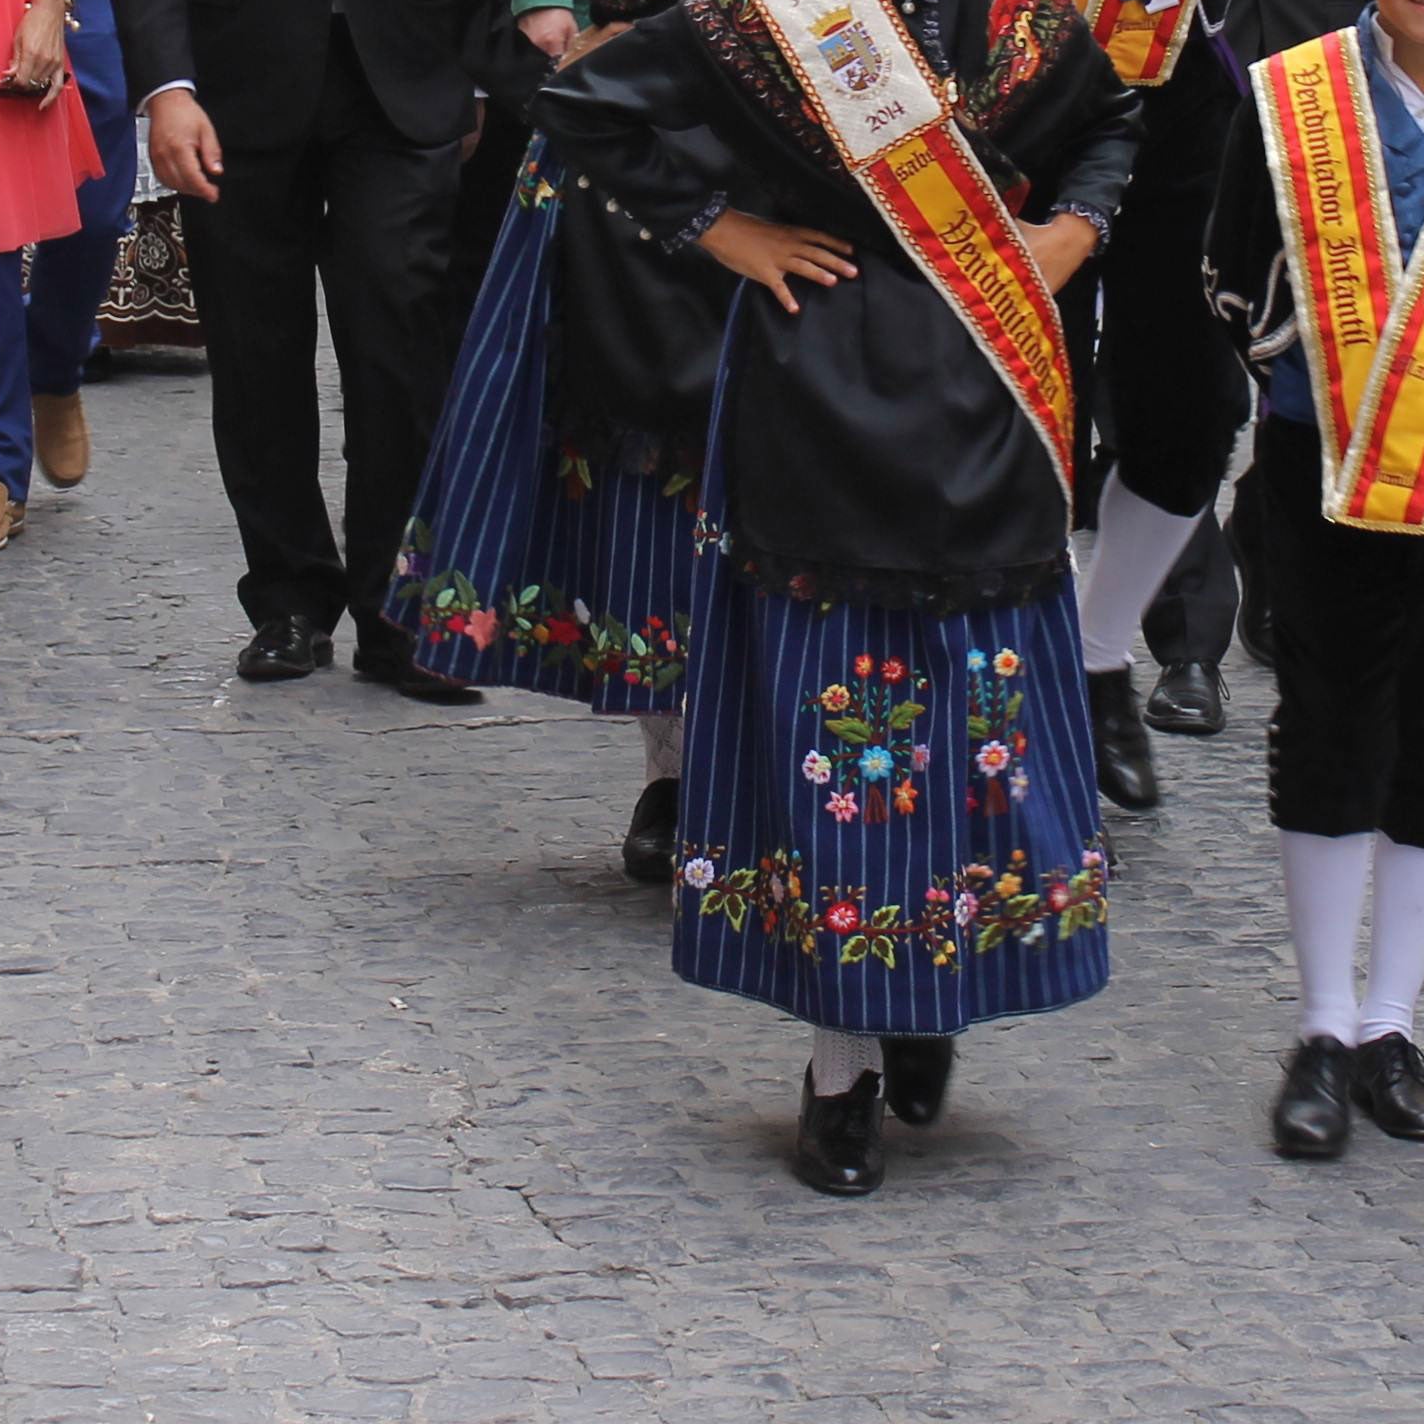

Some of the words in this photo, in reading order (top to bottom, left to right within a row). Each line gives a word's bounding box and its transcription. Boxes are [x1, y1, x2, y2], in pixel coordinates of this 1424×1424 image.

[865, 100, 906, 133] 2014
[1292, 63, 1343, 227] Vendimiador
[1323, 236, 1371, 348] Infantil
[938, 209, 1060, 403] Vendimiadora
